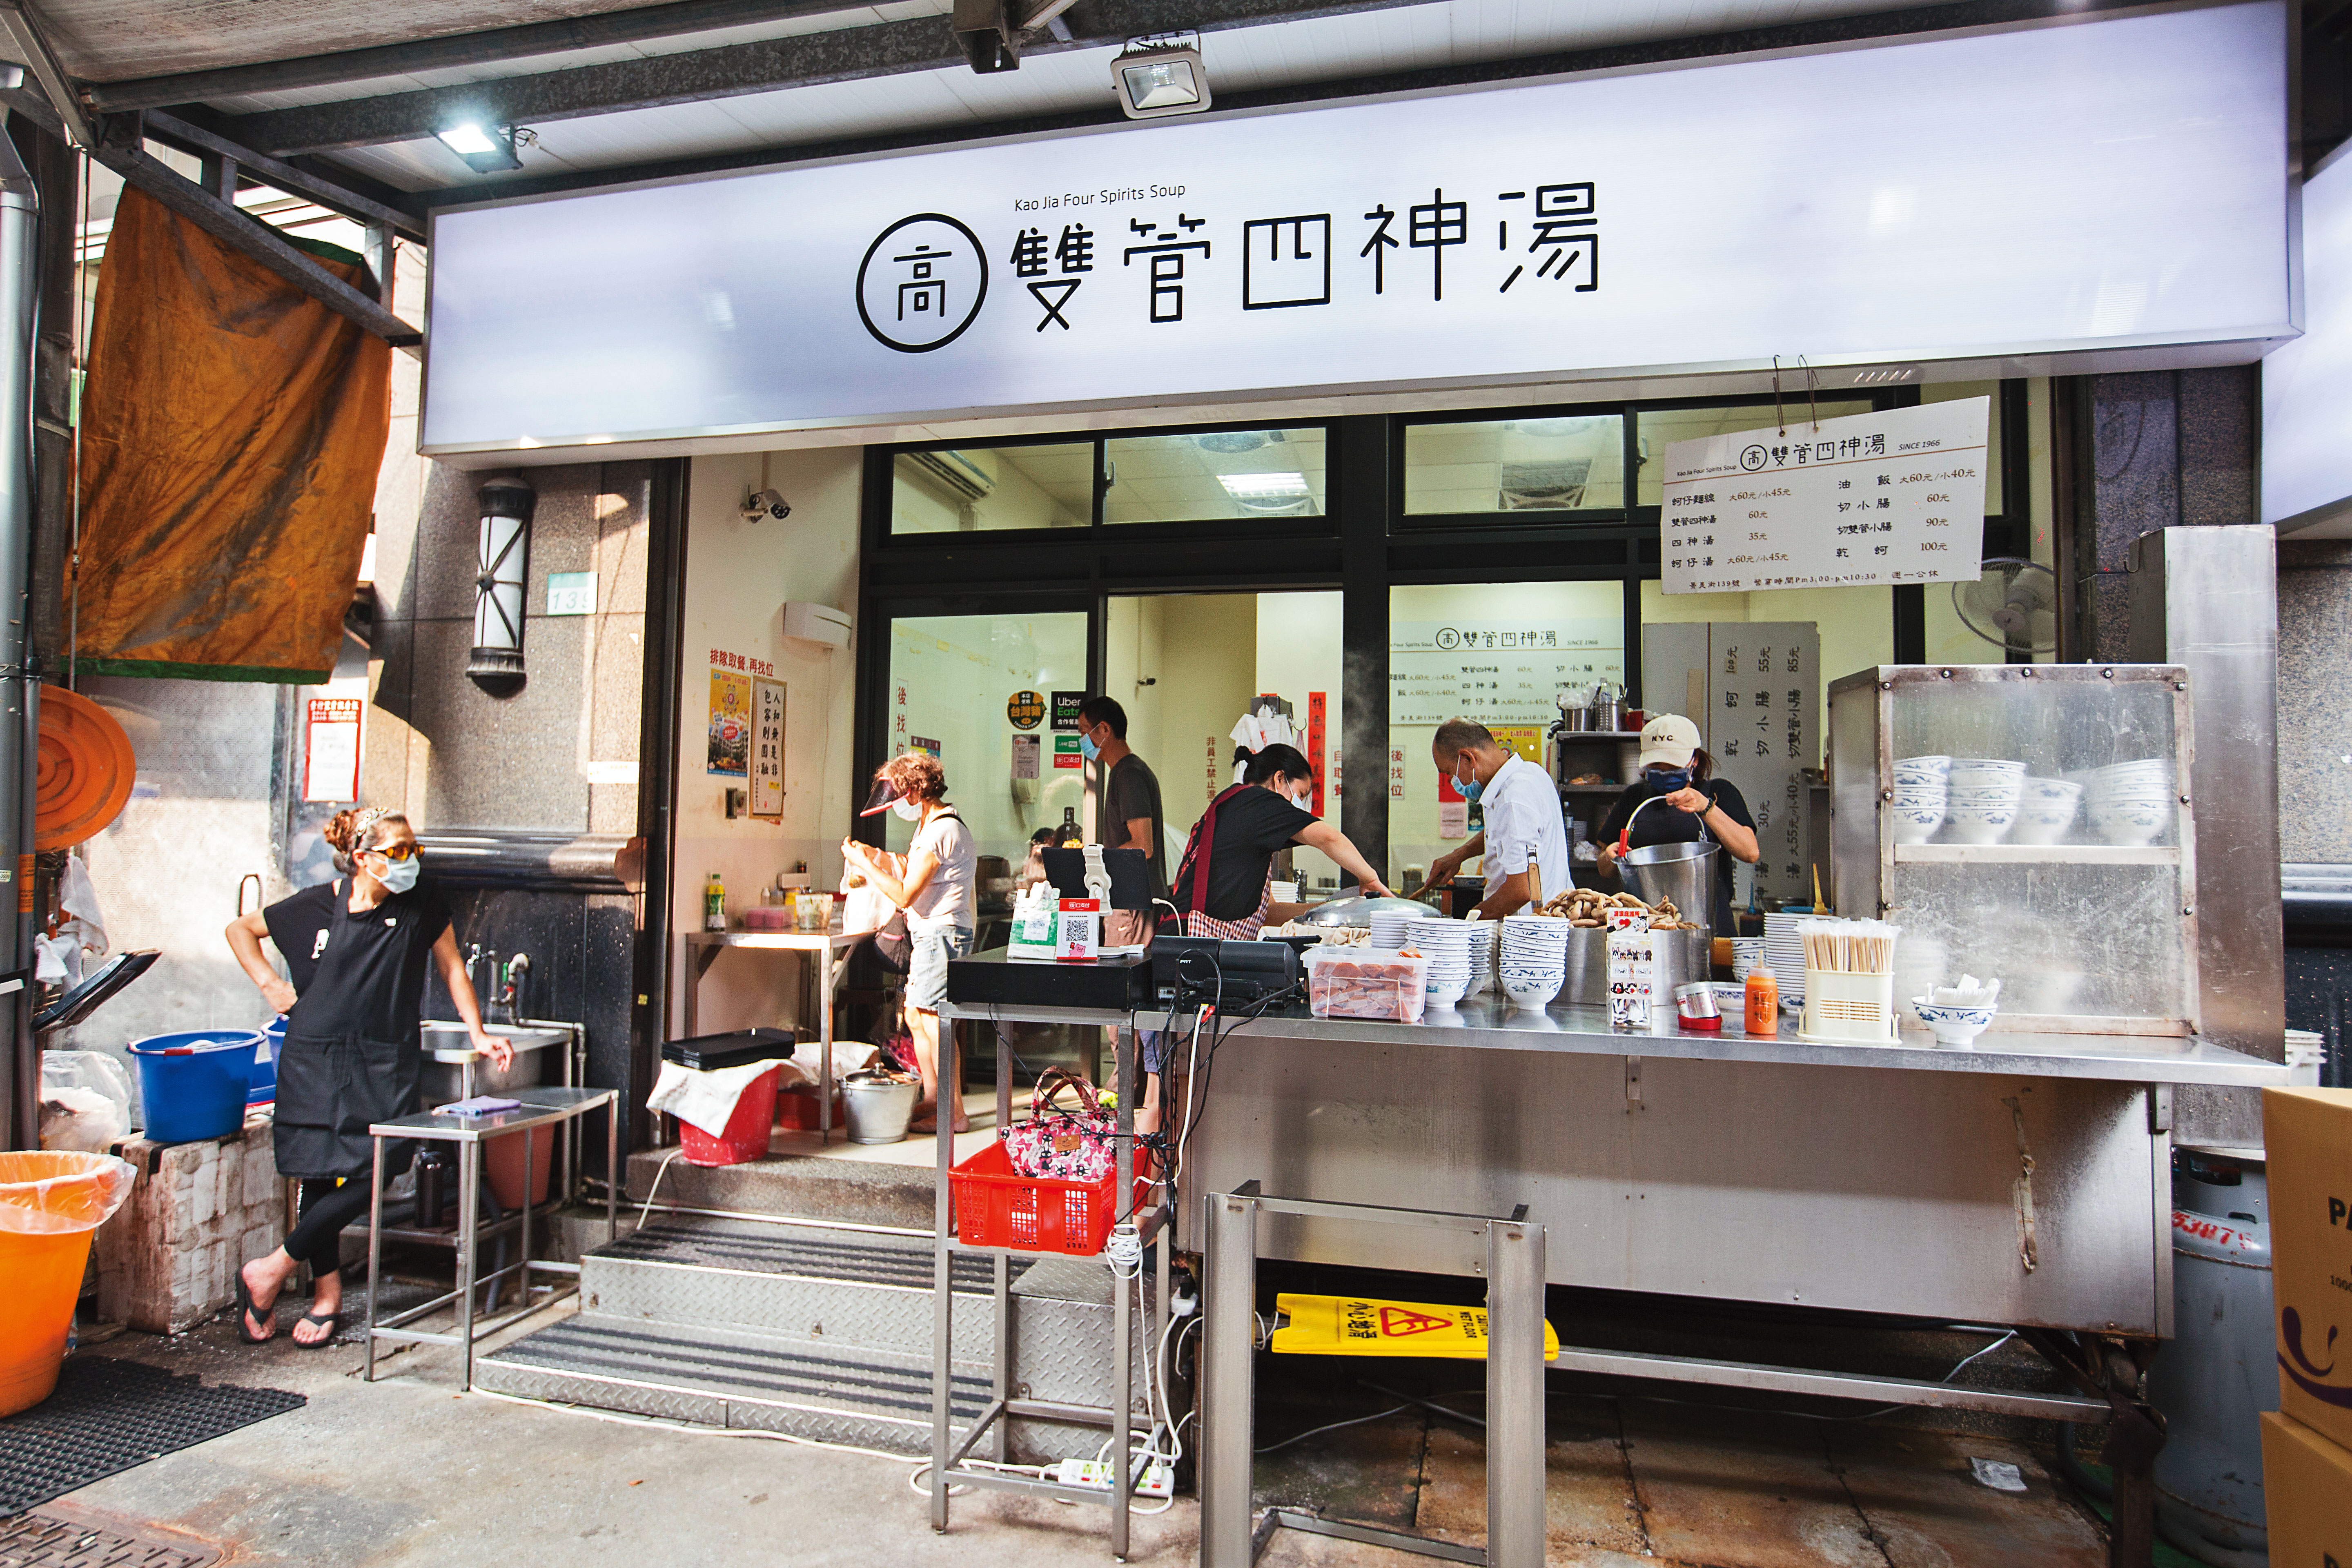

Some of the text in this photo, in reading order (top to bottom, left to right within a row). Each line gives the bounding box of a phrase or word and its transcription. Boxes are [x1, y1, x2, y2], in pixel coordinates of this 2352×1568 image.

[1015, 185, 1185, 212] Kao Jia Four Spirits Soup
[1009, 182, 1599, 332] 雙管四神湯
[1771, 434, 1884, 466] 雙管四神湯
[1671, 493, 1715, 506] 蚵仔麵線
[1838, 498, 1890, 512] 切小腸
[1671, 515, 1716, 527] 雙管四神湯
[1837, 518, 1948, 535] 切雙管小腸 90元
[1671, 535, 1713, 546] 四神湯
[1921, 543, 1947, 551] 100元
[1671, 557, 1713, 568] 蚵仔湯
[1463, 630, 1555, 647] 雙管四神湯
[1758, 646, 1770, 673] 55元
[1058, 697, 1081, 706] Uber
[1058, 707, 1080, 716] Eats
[1787, 646, 1800, 759] 切雙管小腸 85元
[896, 686, 906, 756] 後找位
[1206, 736, 1216, 802] 非員工禁止進
[1391, 750, 1402, 796] 後找位
[1758, 801, 1770, 827] 30元
[1348, 1301, 1377, 1338] 小心地滑
[1459, 1311, 1477, 1338] WET FLOOR
